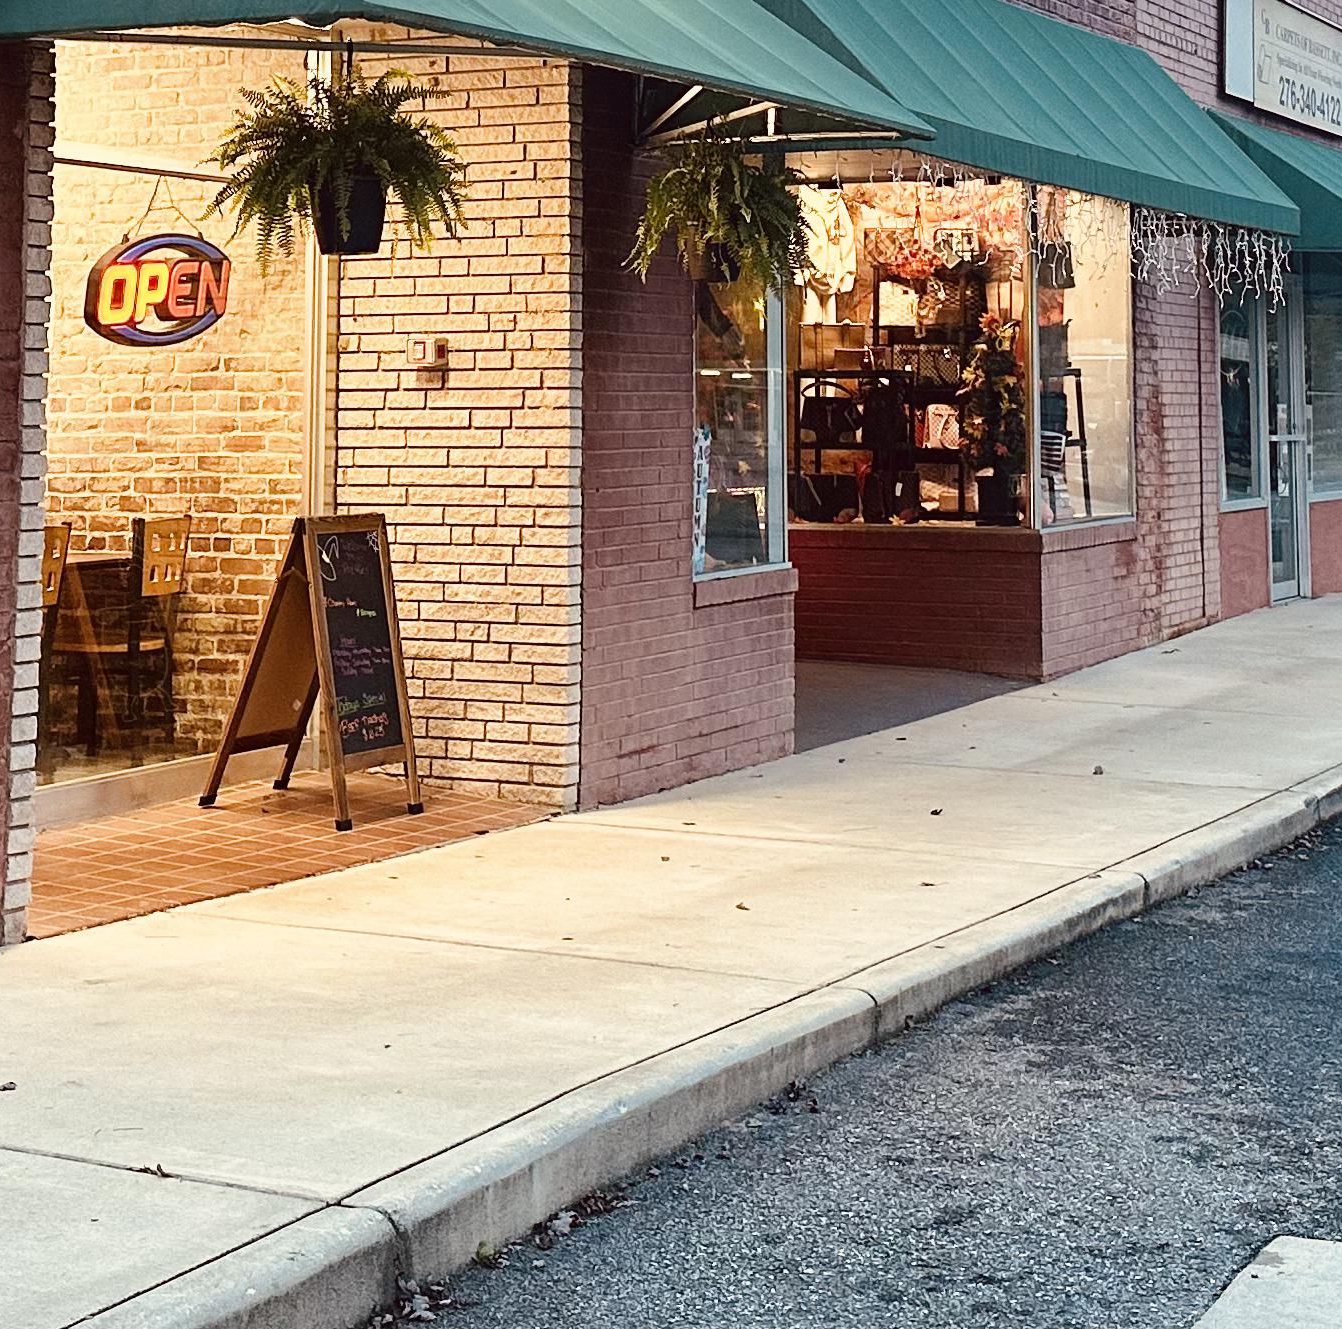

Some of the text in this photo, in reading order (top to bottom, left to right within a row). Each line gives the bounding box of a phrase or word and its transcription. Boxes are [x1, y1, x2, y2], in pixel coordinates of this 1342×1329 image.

[1279, 75, 1341, 127] 276-340-4122
[97, 260, 231, 325] OPEN
[694, 445, 704, 548] AUTUMN
